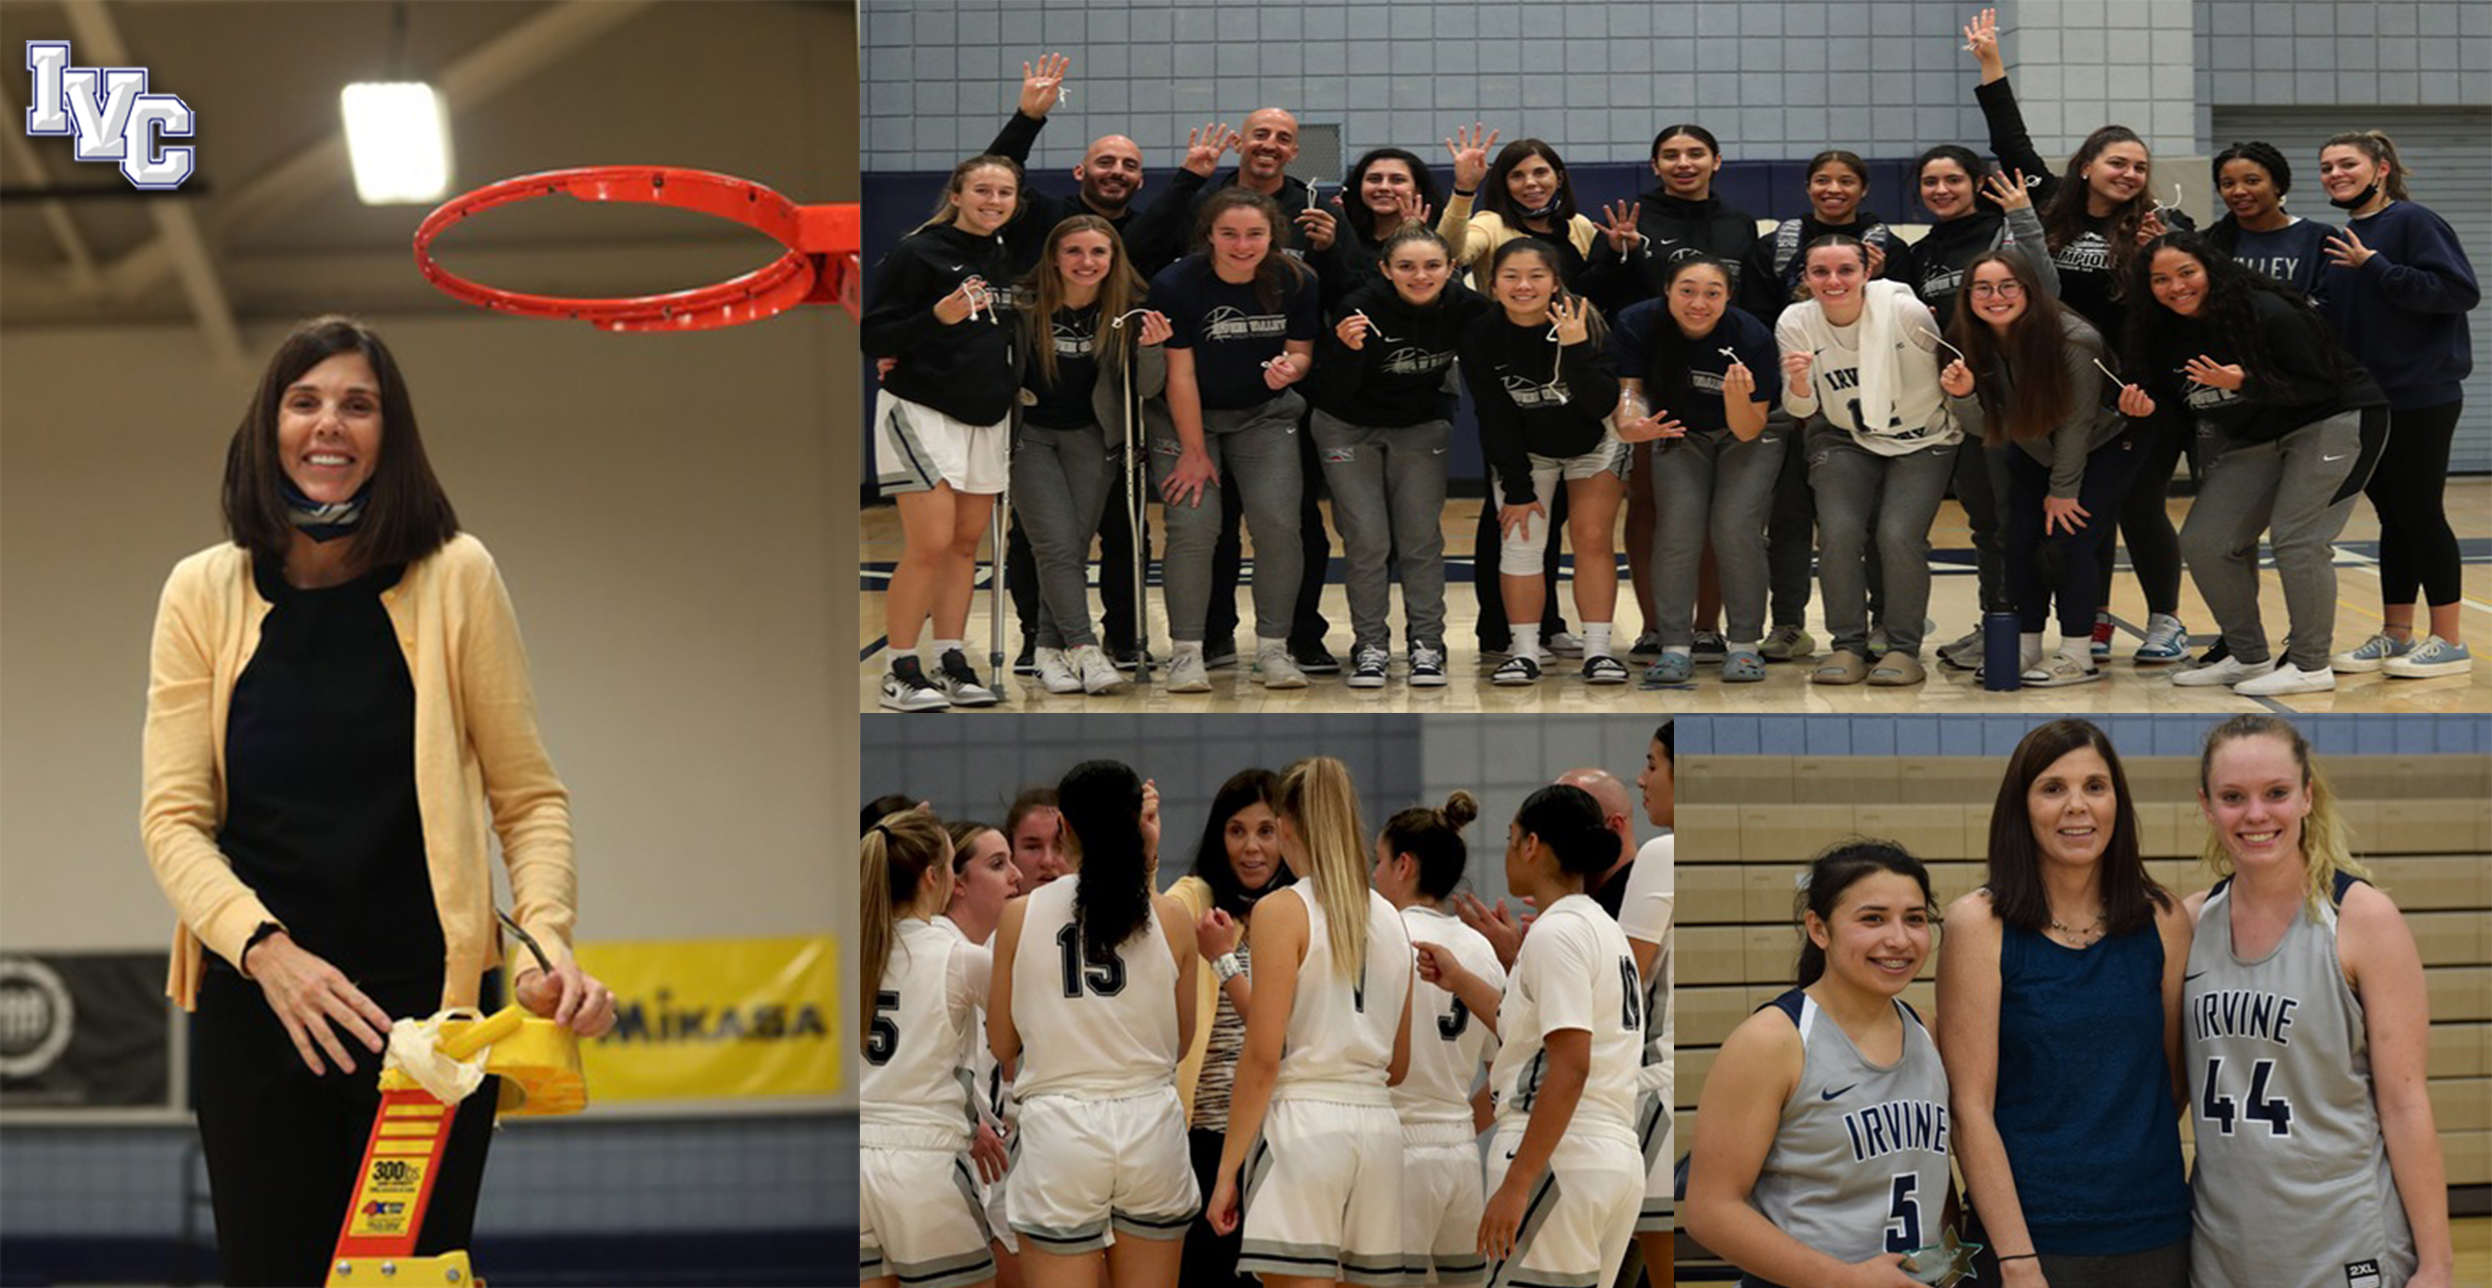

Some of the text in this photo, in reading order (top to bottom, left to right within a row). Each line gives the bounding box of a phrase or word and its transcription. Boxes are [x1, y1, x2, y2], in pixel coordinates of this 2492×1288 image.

[1057, 923, 1127, 998] 15
[2194, 989, 2299, 1047] IRVINE
[1844, 1099, 1947, 1163] IRVINE
[2201, 1056, 2294, 1138] 44
[1883, 1170, 1923, 1257] 5
[2350, 1263, 2376, 1276] 2XL
